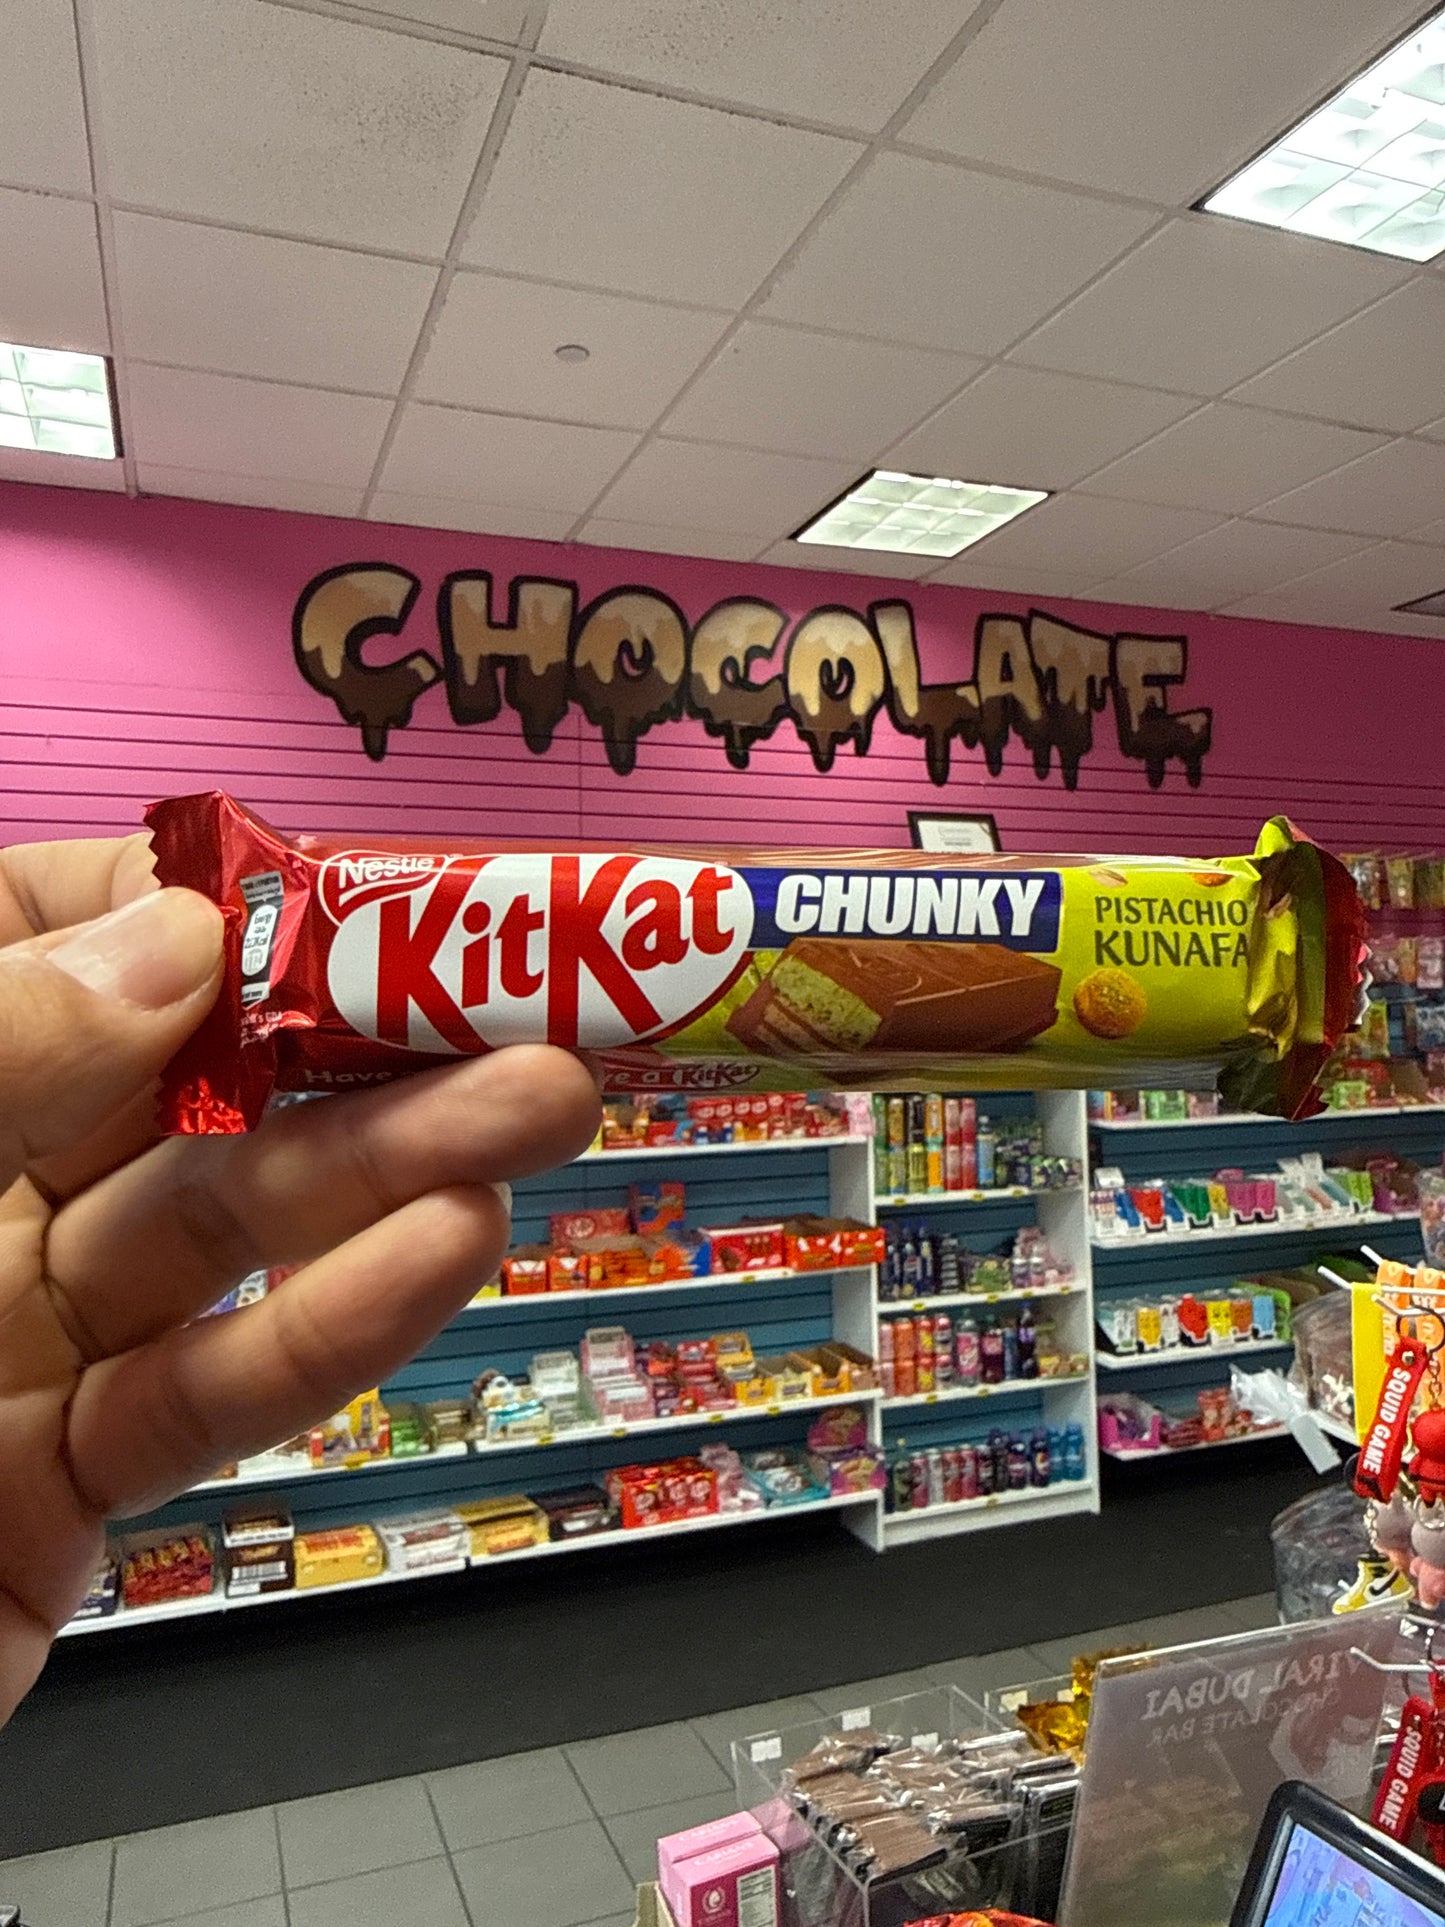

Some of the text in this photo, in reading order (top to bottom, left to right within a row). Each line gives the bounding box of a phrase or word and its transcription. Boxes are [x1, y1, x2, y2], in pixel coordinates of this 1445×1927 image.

[292, 561, 1212, 790] CHOCOLATE
[774, 873, 1046, 937] CHUNKY
[1094, 895, 1249, 926] PISTACHIO
[376, 856, 735, 1052] KitKat
[1094, 929, 1251, 967] KUNAFA
[304, 1068, 393, 1084] Have
[1380, 1367, 1411, 1423] SQUID
[1363, 1424, 1392, 1476] GAME
[1380, 1726, 1422, 1831] SQUID GAME
